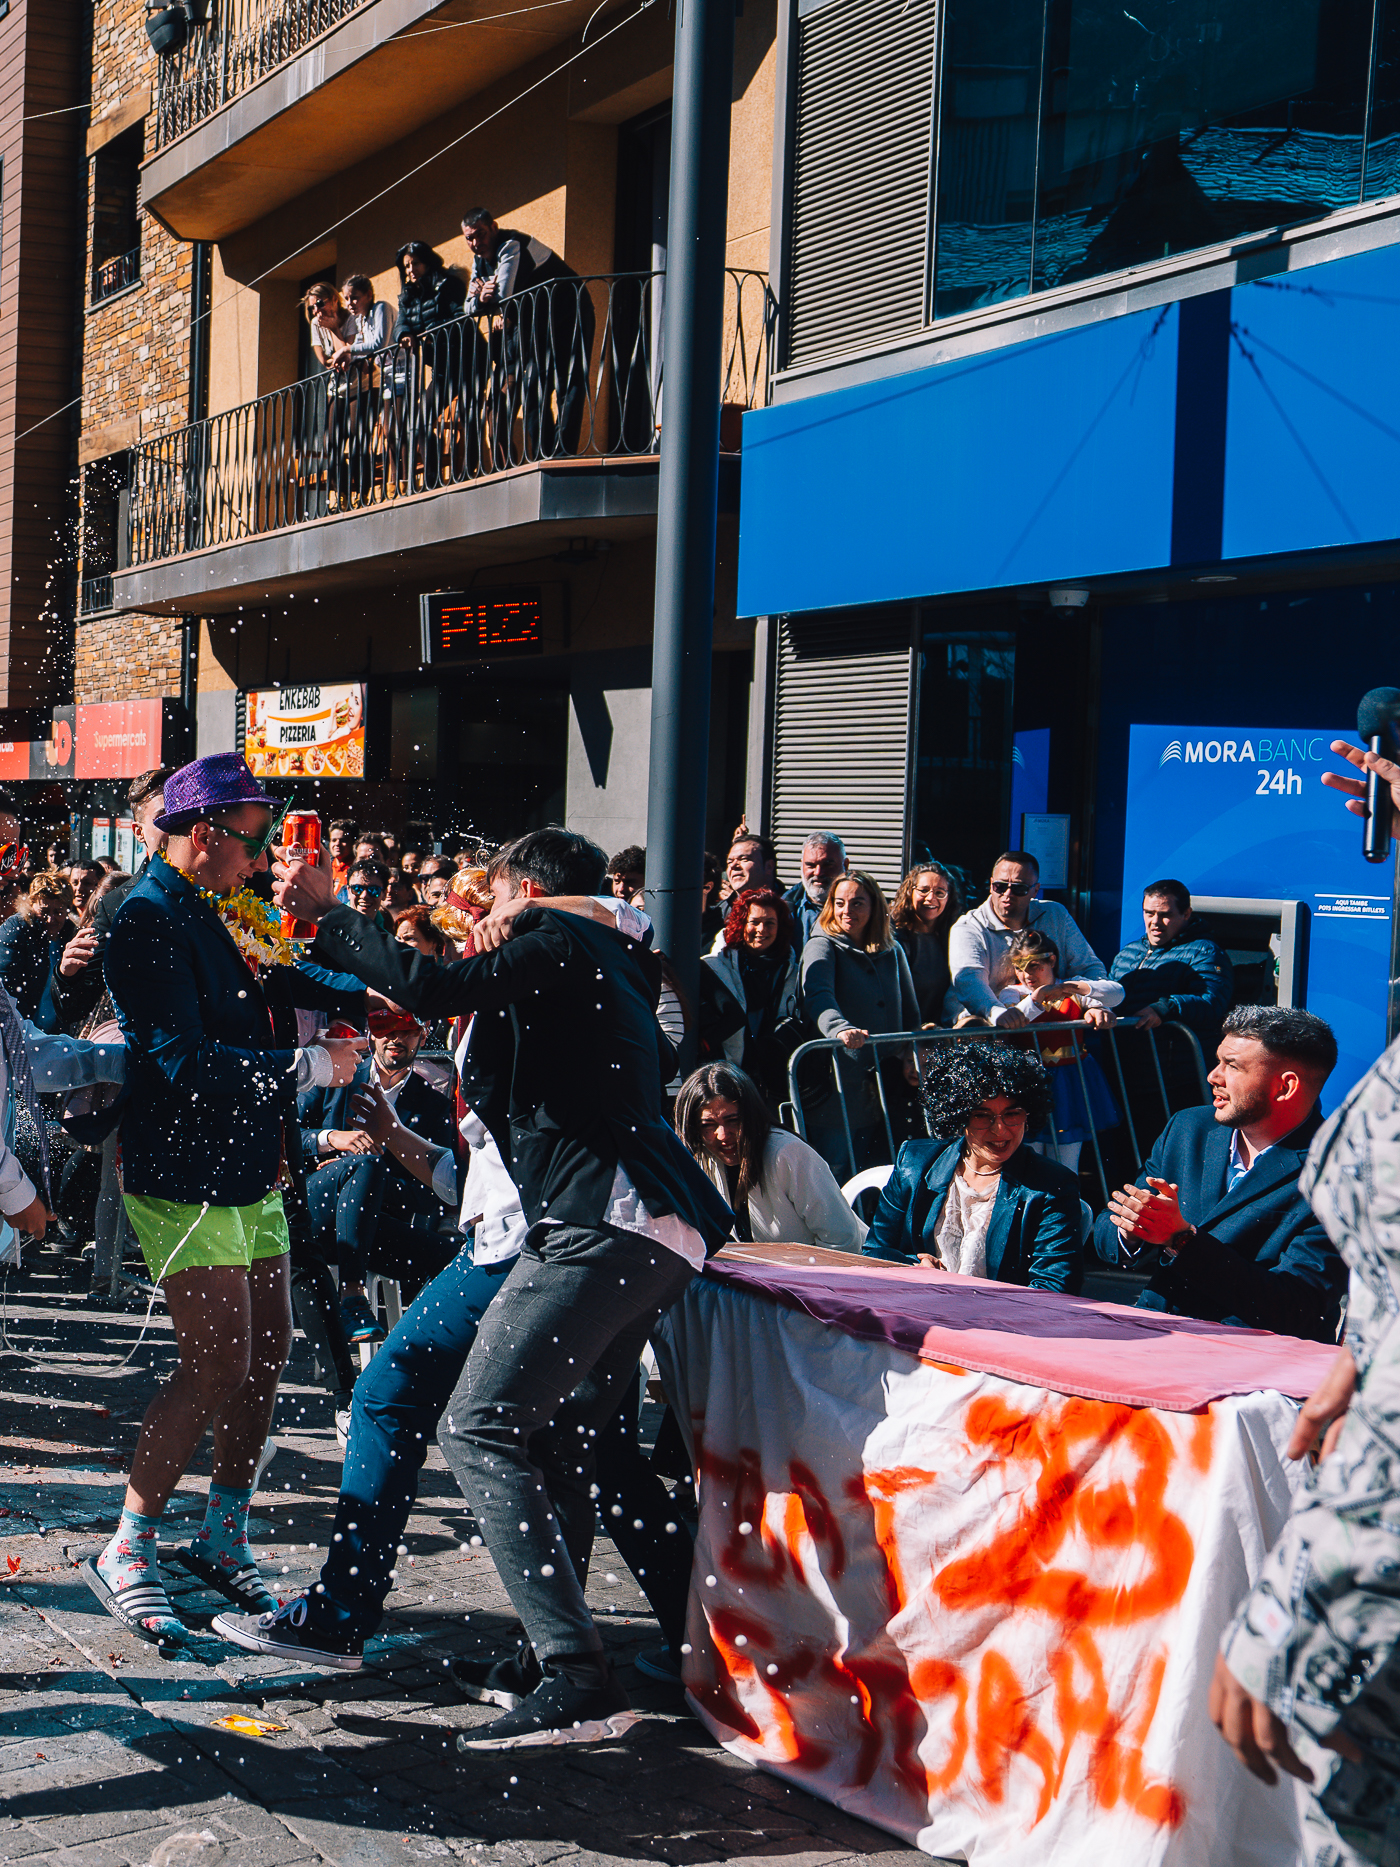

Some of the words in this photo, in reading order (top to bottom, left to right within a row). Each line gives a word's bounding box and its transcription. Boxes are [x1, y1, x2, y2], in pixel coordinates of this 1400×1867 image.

[94, 729, 147, 751] Supermercats
[280, 725, 316, 742] PIZZERIA
[1185, 738, 1324, 763] MORABANC
[1256, 768, 1302, 795] 24h
[108, 1600, 128, 1623] adidas
